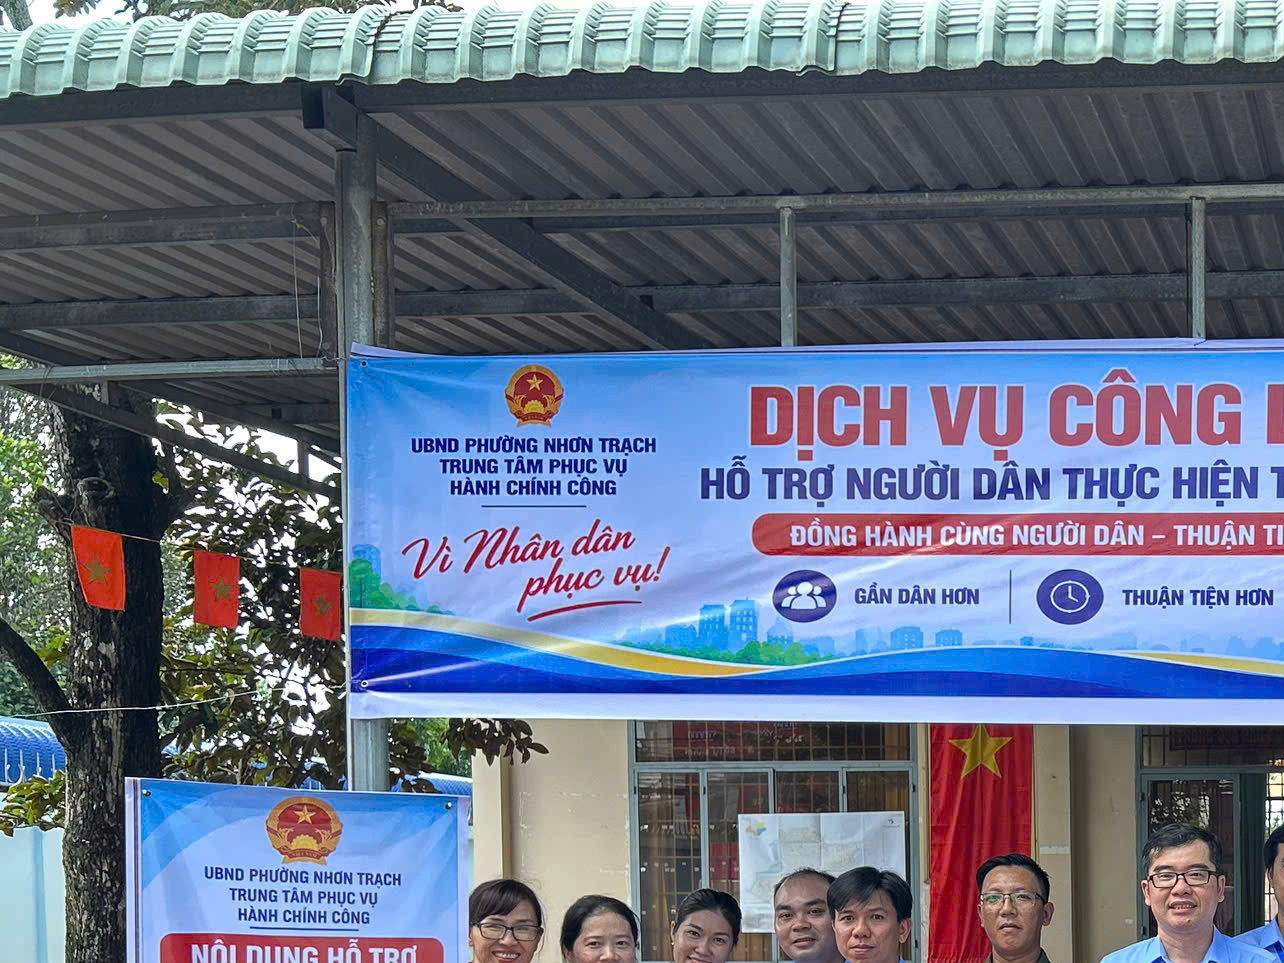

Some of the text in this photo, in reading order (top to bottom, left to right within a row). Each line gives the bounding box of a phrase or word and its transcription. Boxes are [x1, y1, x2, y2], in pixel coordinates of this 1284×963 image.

[751, 385, 908, 462] DỊCH
[931, 386, 1024, 463] VỤ
[1049, 368, 1242, 448] CÔNG
[411, 435, 656, 456] UBND PHƯỜNG NHƠN TRẠCH
[440, 455, 627, 477] TRUNG TÂM PHỤC VỤ
[451, 477, 616, 495] HÀNH CHÍNH CÔNG
[701, 455, 750, 500] HỖ
[762, 464, 834, 507] TRỢ
[847, 460, 959, 500] NGƯỜI
[973, 461, 1050, 500] DÂN
[1062, 464, 1159, 507] THỰC
[1173, 459, 1259, 507] HIỆN
[790, 518, 856, 546] ĐỒNG
[865, 521, 938, 551] HÀNH
[936, 522, 1004, 548] CÙNG
[1013, 520, 1085, 545] NGƯỜI
[1094, 520, 1144, 545] DÂN
[1173, 520, 1254, 550] THUẬN
[402, 519, 635, 580] Vì Nhân dân
[516, 547, 672, 614] phục vụ!
[855, 582, 979, 604] GẦN DÂN HƠN
[1122, 586, 1273, 609] THUẬN TIỆN HƠN
[205, 866, 401, 888] UBND PHƯỜNG NHƠN TRẠCH
[229, 887, 377, 908] TRUNG TÂM PHỤC VỤ
[238, 906, 370, 924] HÀNH CHÍNH CÔNG
